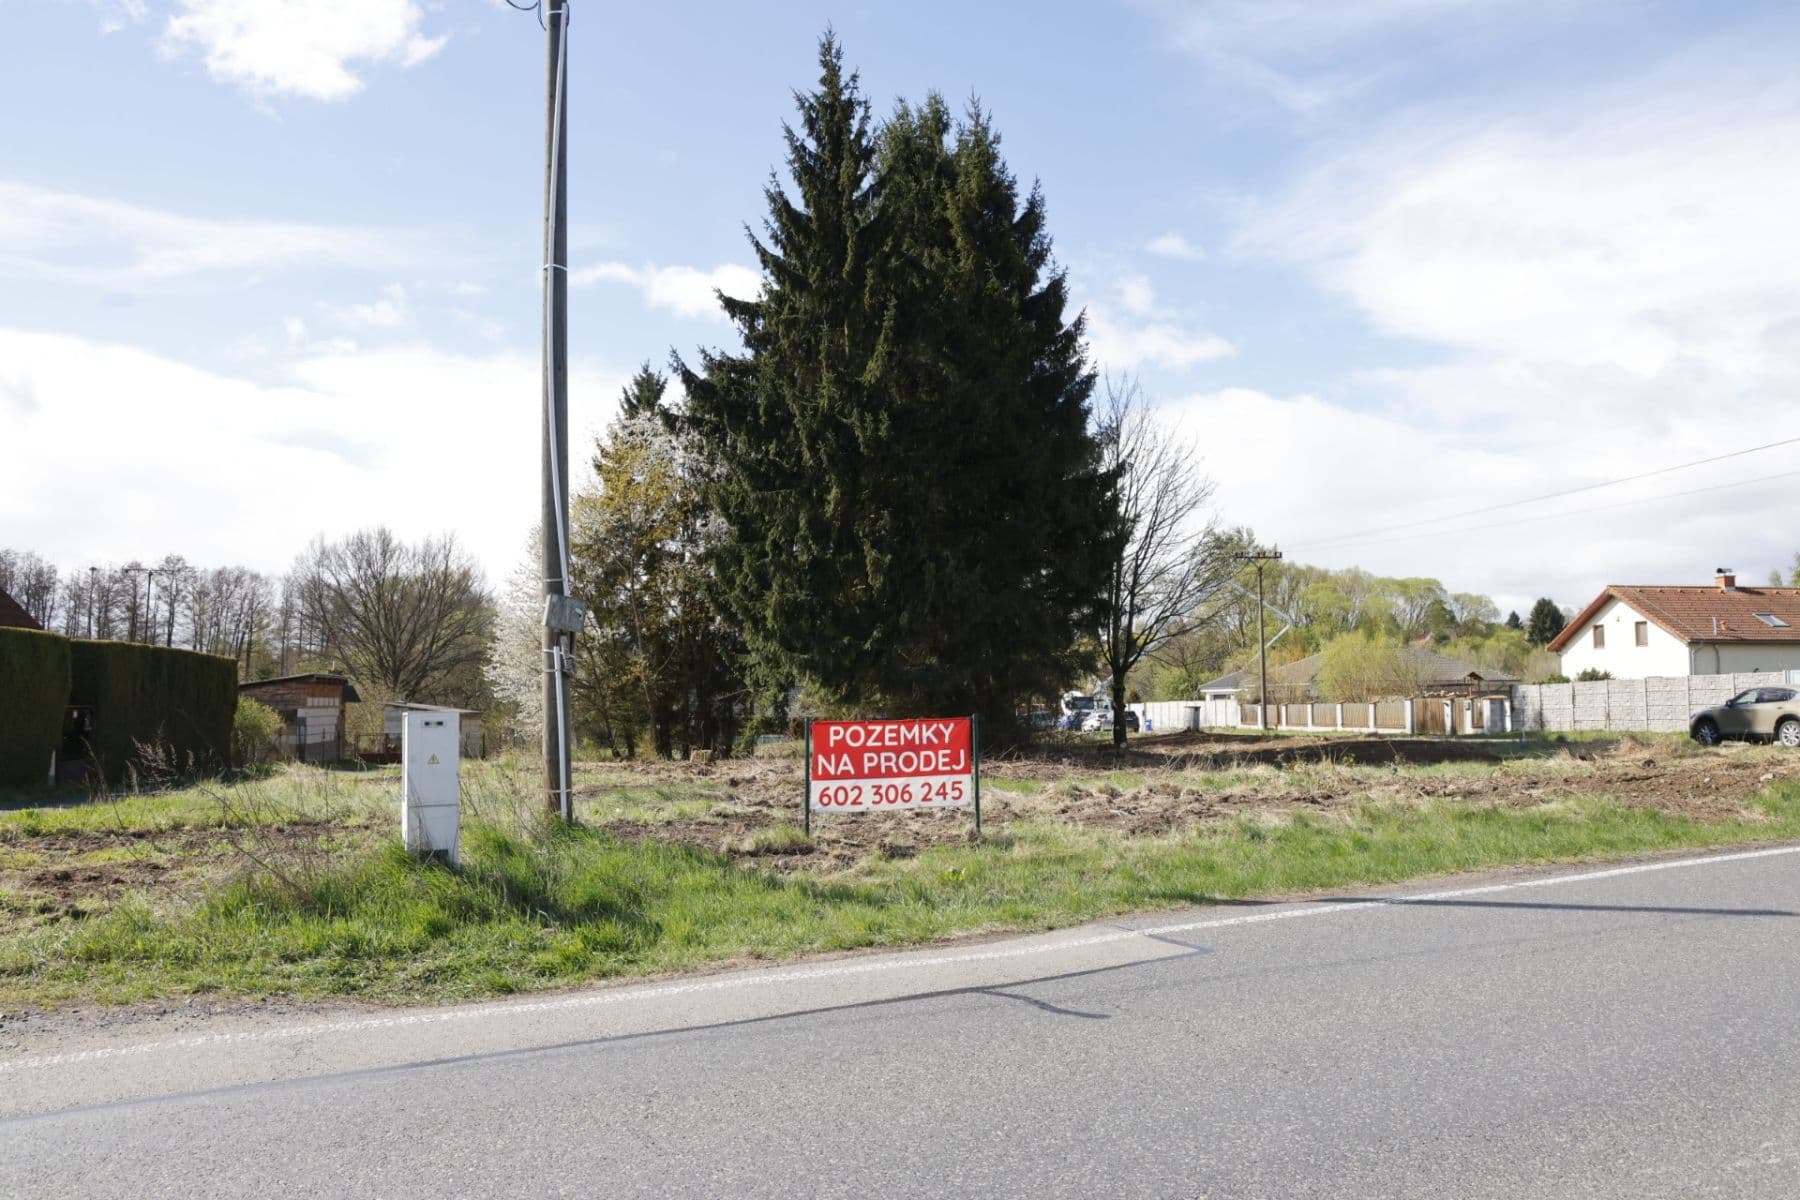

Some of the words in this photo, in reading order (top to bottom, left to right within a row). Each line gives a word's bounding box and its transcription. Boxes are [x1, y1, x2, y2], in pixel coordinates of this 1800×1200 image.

[829, 722, 954, 747] POZEMKY
[817, 753, 855, 776] NA
[863, 749, 965, 774] PRODEJ
[819, 785, 863, 807] 602
[871, 783, 913, 805] 306
[920, 781, 963, 803] 245
